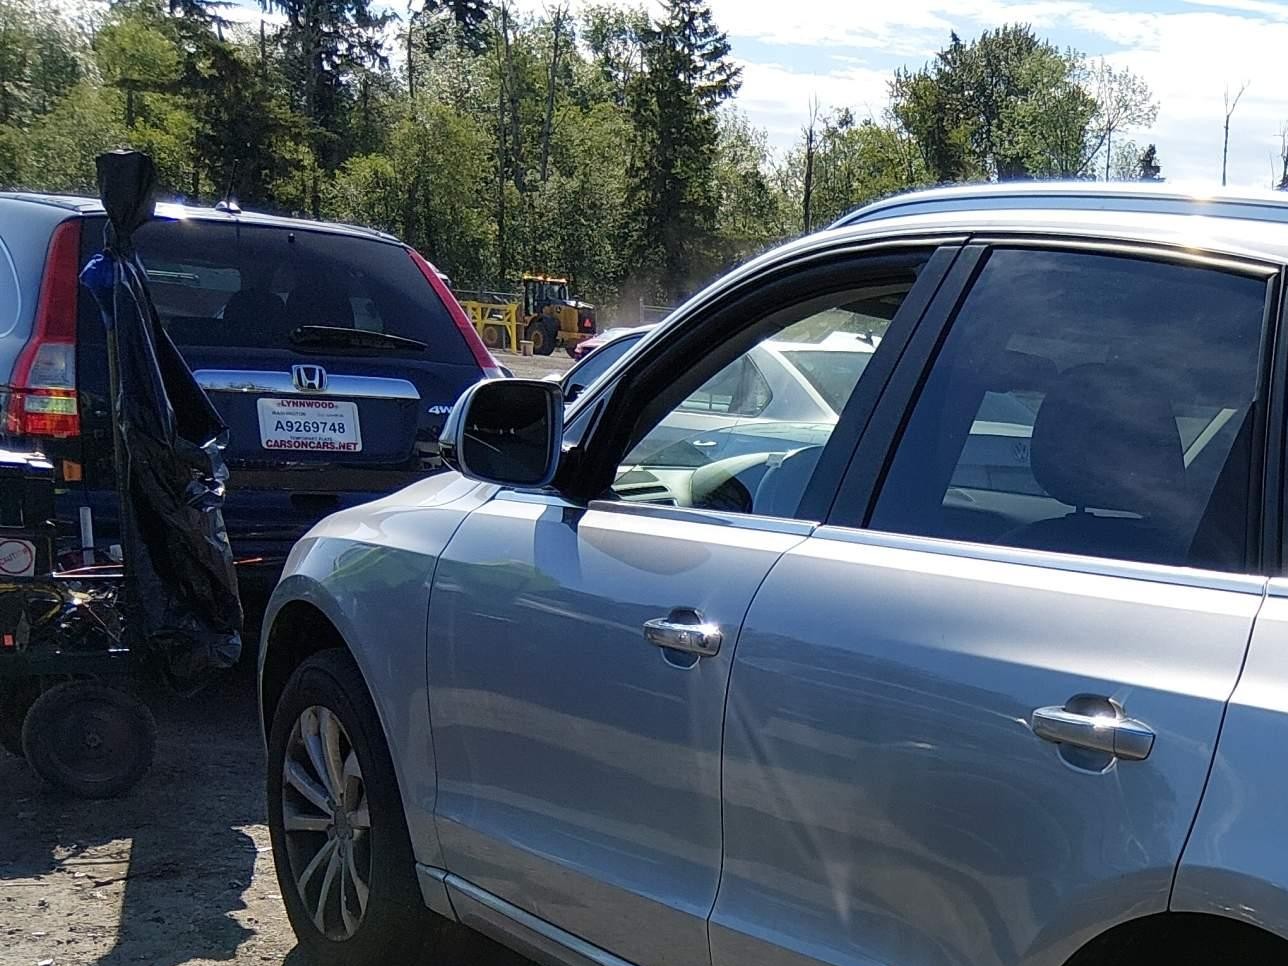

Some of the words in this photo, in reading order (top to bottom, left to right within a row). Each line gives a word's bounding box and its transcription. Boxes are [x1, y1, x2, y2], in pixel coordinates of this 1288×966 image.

[281, 400, 335, 409] LYNNWOOD
[428, 405, 453, 415] 4W
[274, 420, 346, 434] A9269748
[266, 440, 358, 451] CARSONCARS.NET
